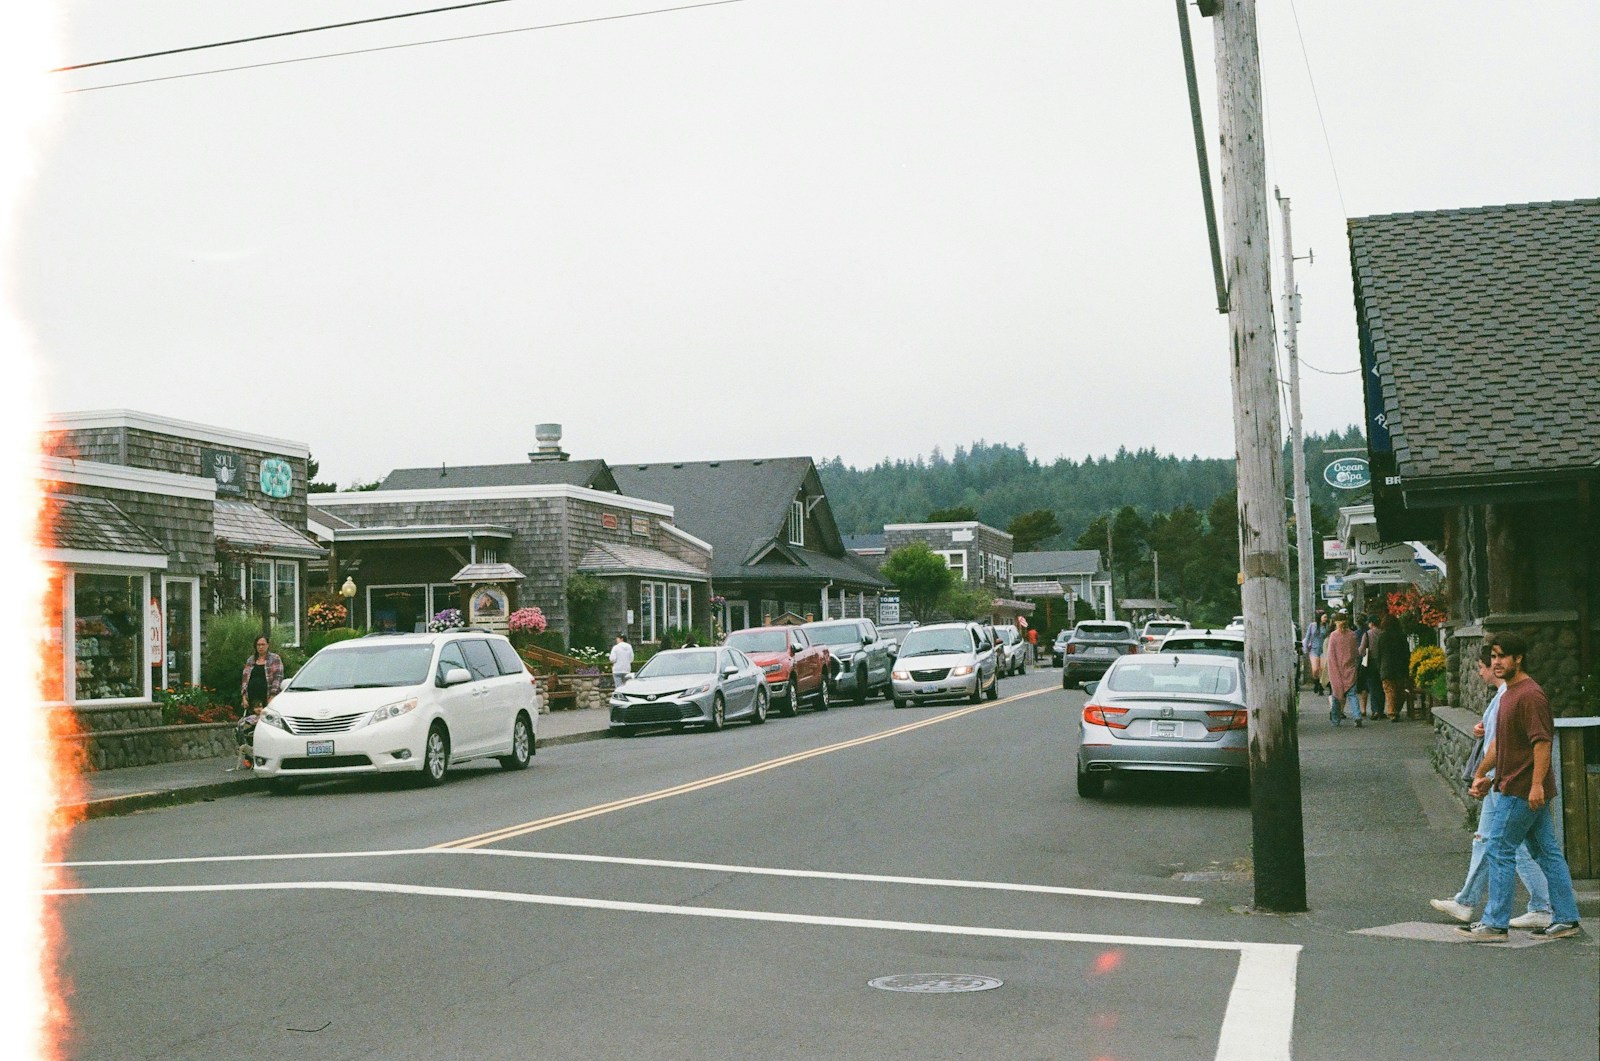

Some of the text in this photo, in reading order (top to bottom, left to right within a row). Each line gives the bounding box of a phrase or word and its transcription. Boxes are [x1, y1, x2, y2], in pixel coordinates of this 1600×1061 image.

[215, 454, 234, 467] SOUL
[1334, 463, 1364, 472] Ocean
[1346, 472, 1364, 482] Spa
